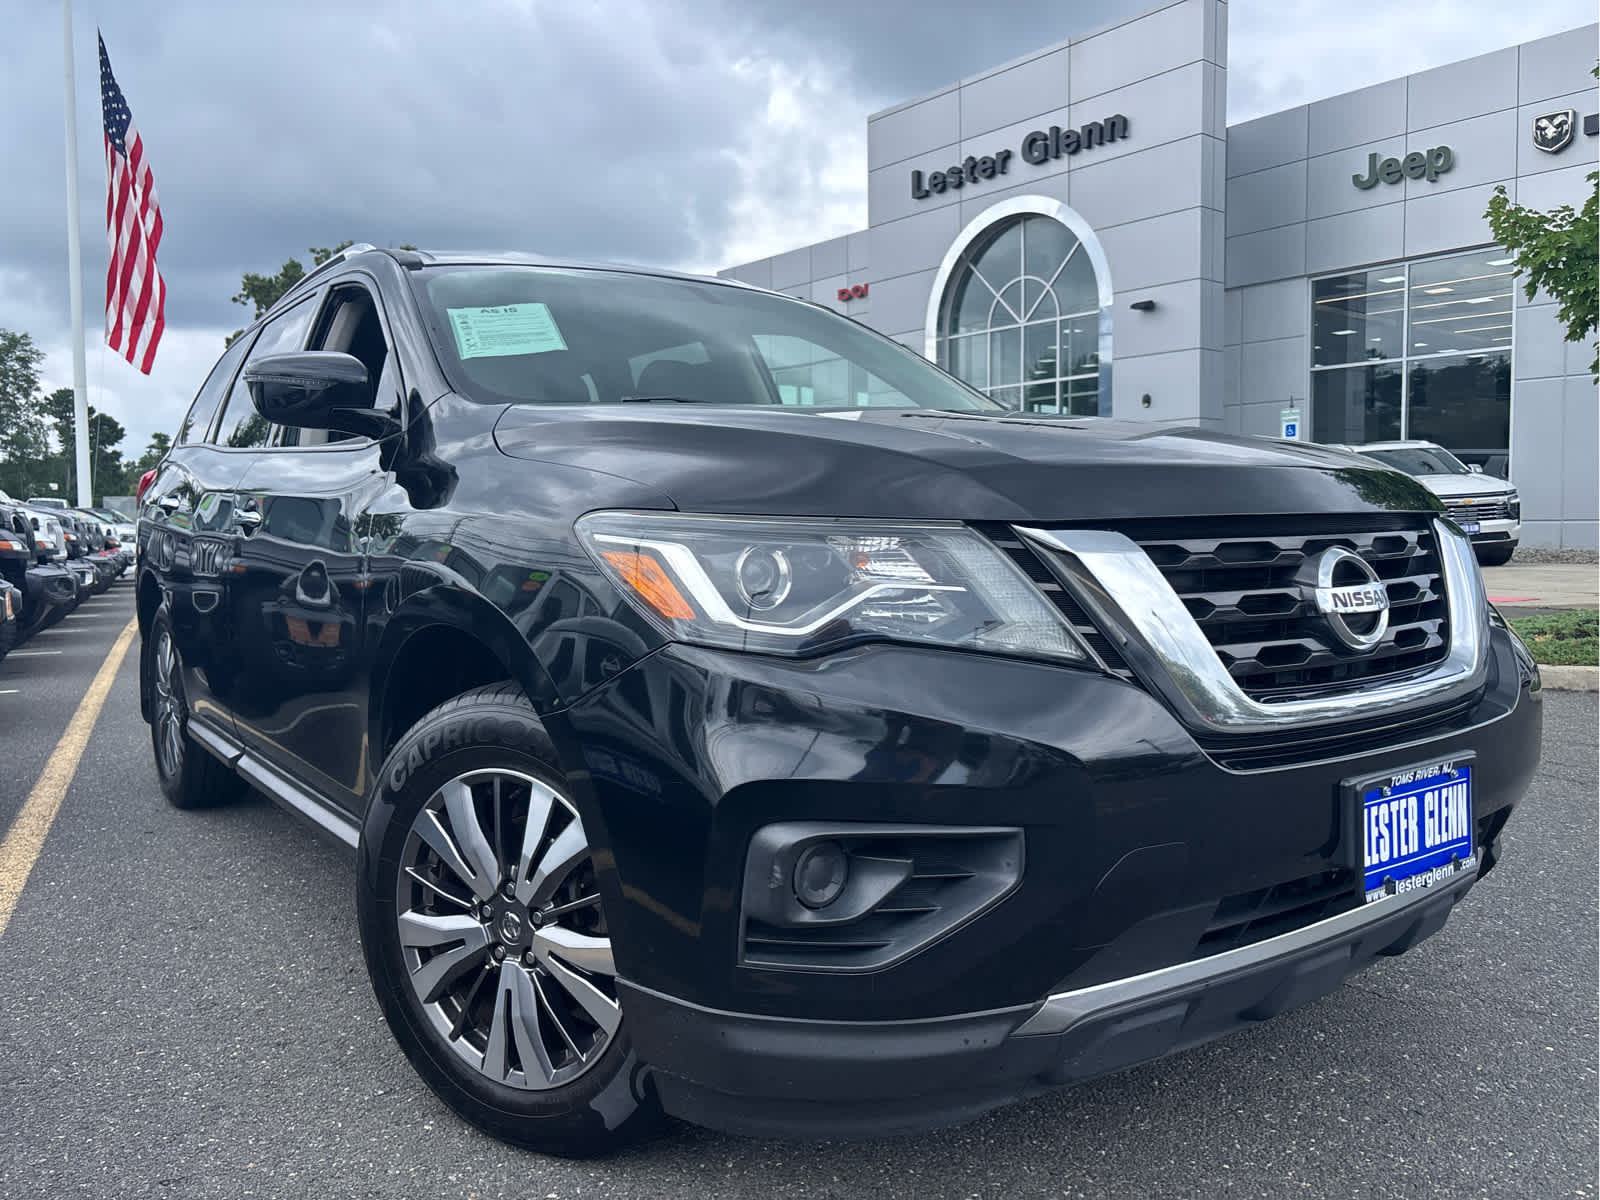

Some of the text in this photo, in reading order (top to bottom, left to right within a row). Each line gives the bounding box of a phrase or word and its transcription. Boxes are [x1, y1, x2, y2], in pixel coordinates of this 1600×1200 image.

[911, 113, 1130, 200] Lester Glenn
[1352, 145, 1455, 190] Jeep
[1331, 589, 1388, 609] NISSAN
[1391, 771, 1414, 787] TOMS
[1441, 760, 1454, 774] NJ
[1364, 783, 1468, 867] LESTER GLENN
